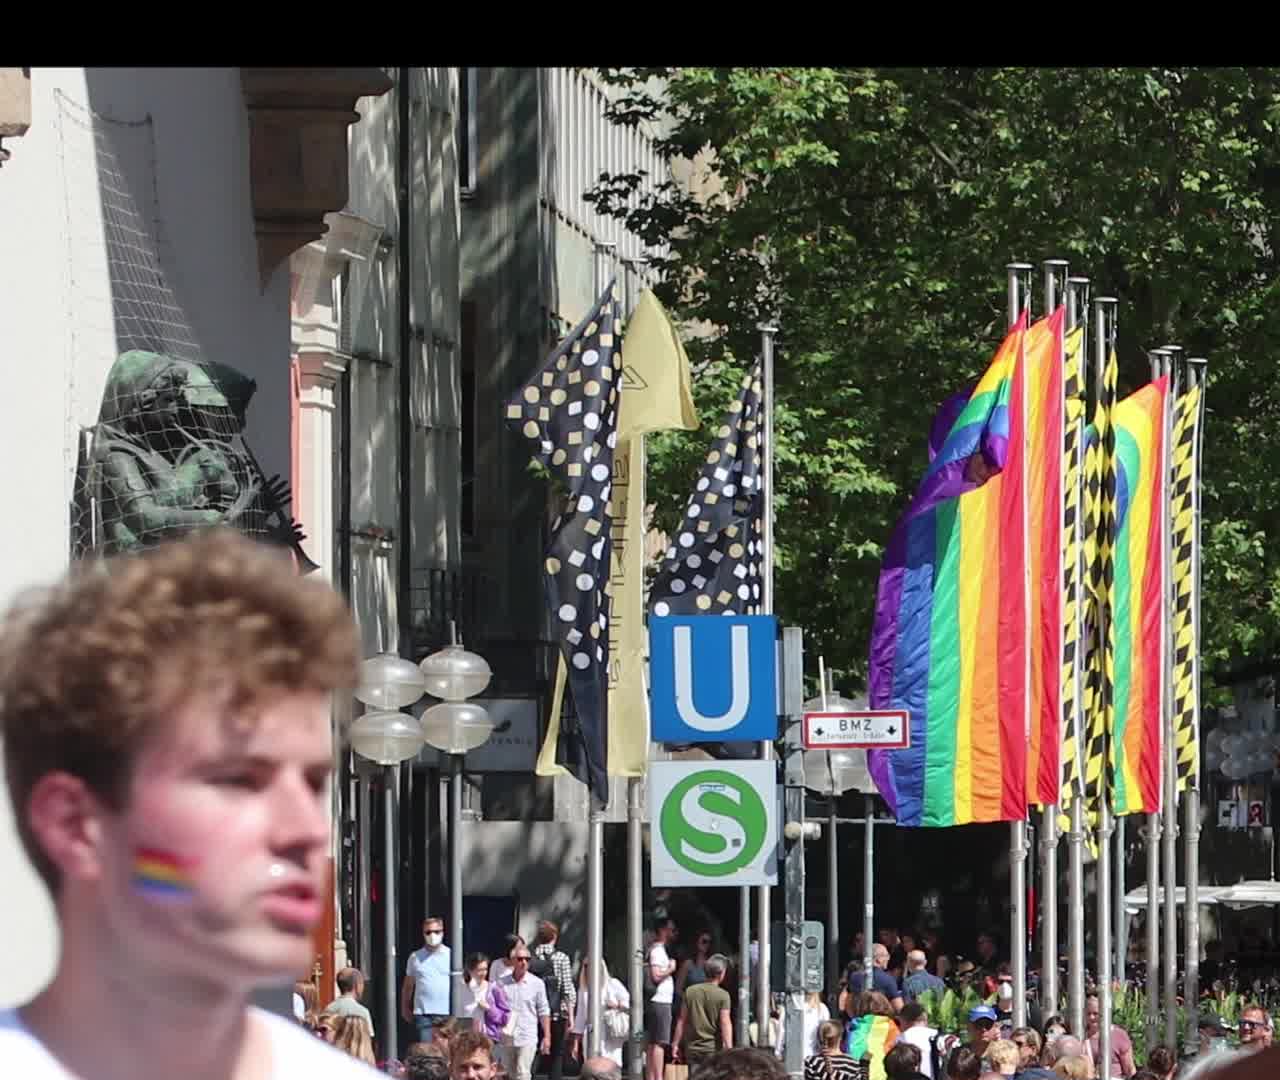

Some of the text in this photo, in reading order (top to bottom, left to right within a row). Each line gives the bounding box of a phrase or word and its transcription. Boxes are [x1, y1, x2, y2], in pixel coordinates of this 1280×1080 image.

[673, 625, 750, 732] U
[838, 718, 873, 732] BMZ
[680, 784, 748, 865] S
